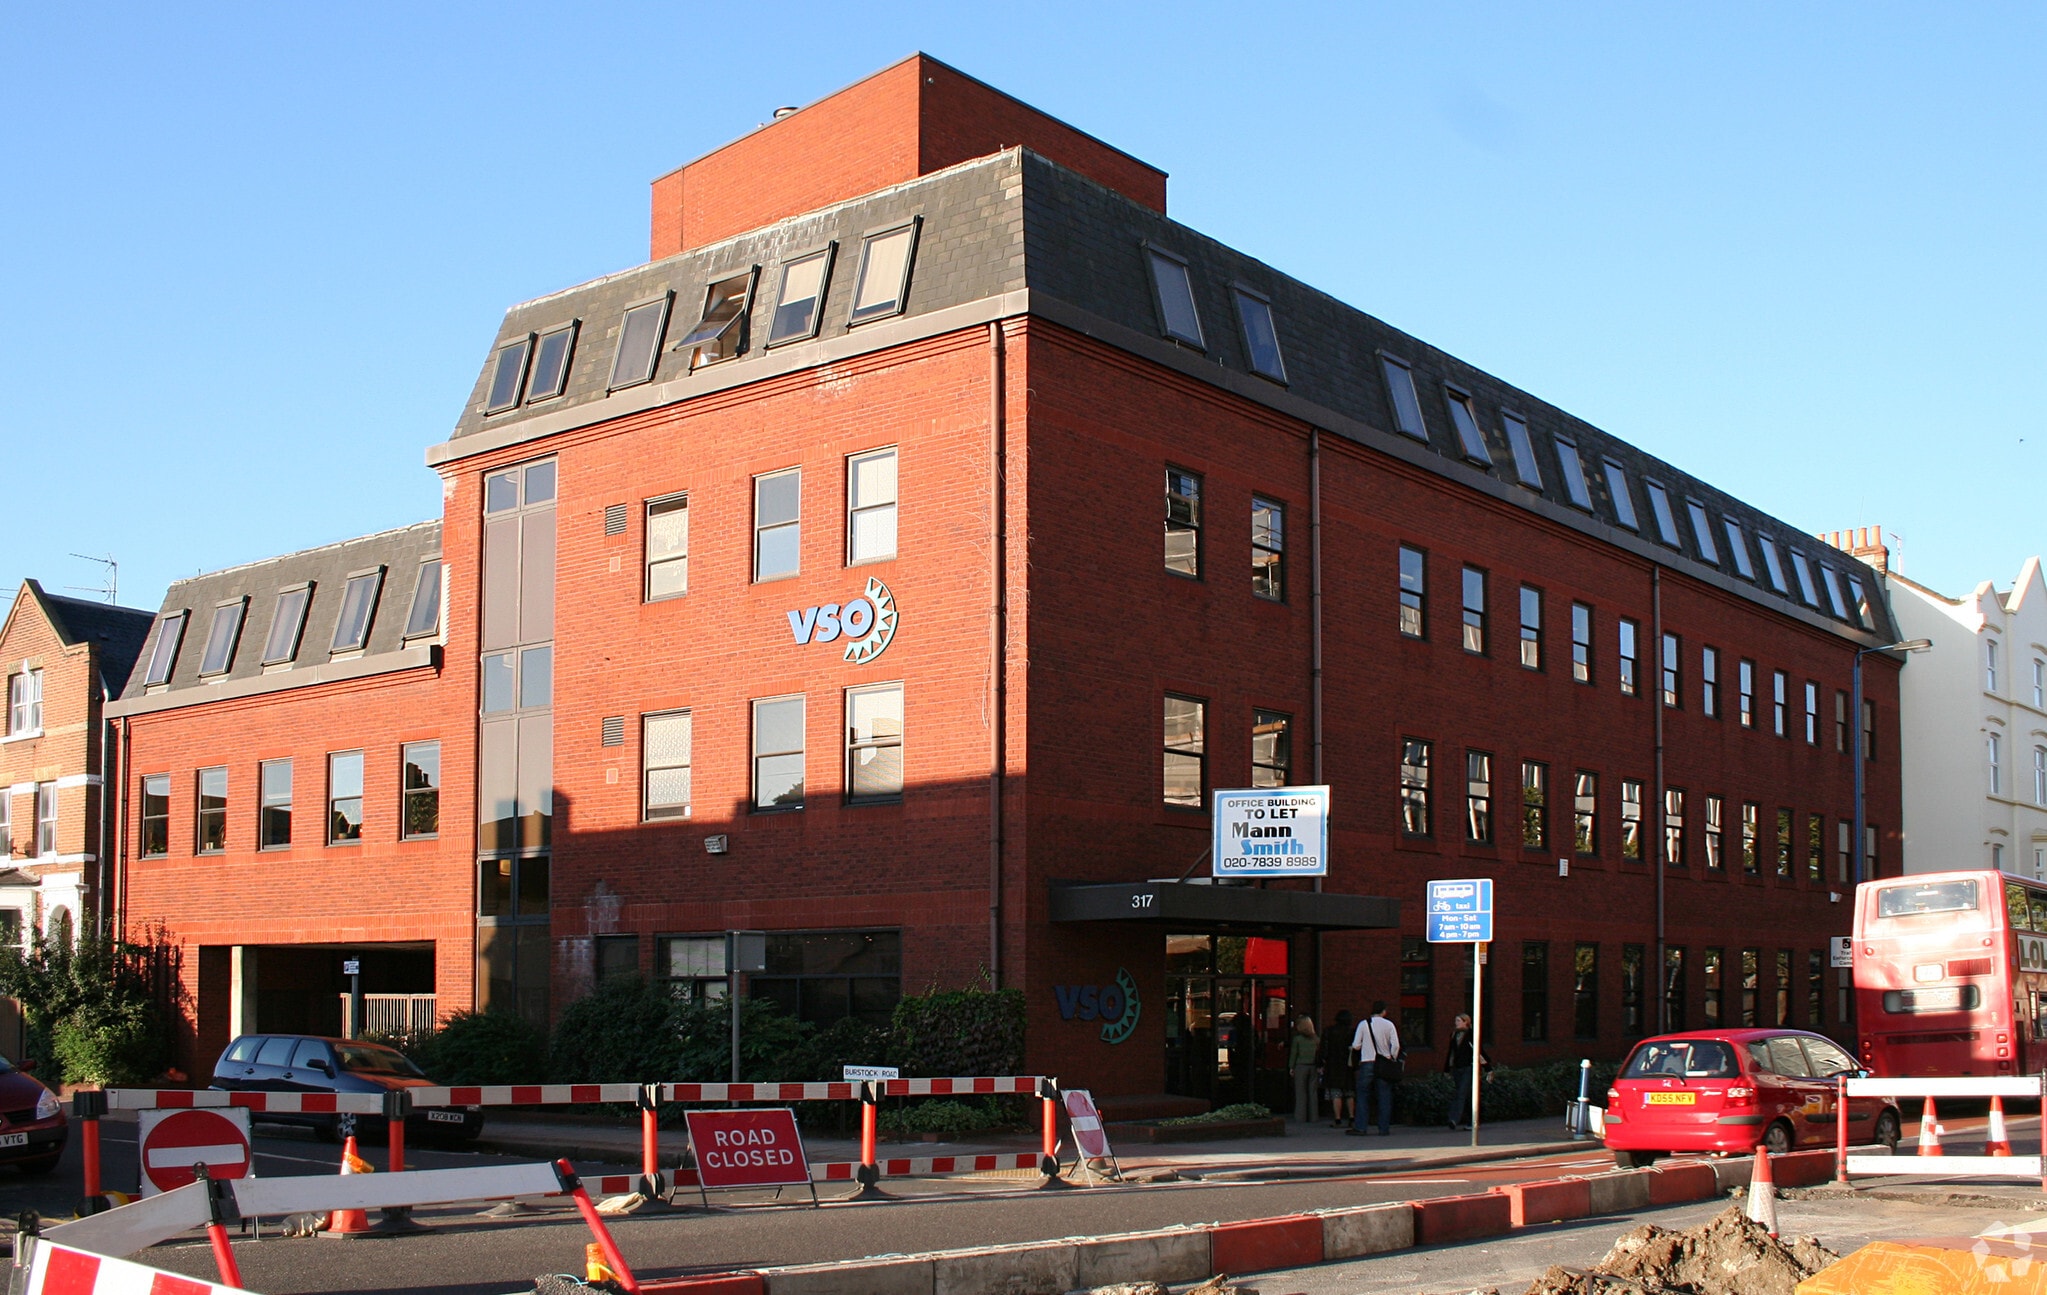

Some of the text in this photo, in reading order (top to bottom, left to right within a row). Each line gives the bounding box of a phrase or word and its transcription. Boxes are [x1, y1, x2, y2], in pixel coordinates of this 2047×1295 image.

[787, 598, 875, 645] VSO
[1227, 798, 1316, 808] OFFICE BUILDING
[1245, 808, 1298, 819] TO LET
[1232, 822, 1292, 838] Mann
[1240, 839, 1304, 855] Smith
[1223, 856, 1317, 868] 020-7839 8989
[1131, 894, 1154, 908] 317
[1463, 914, 1477, 922] Sat
[1054, 985, 1125, 1020] VSO
[845, 1068, 897, 1078] BURSTOCK ROAD
[4, 1134, 23, 1145] VTG
[714, 1129, 776, 1147] ROAD
[706, 1149, 794, 1168] CLOSED
